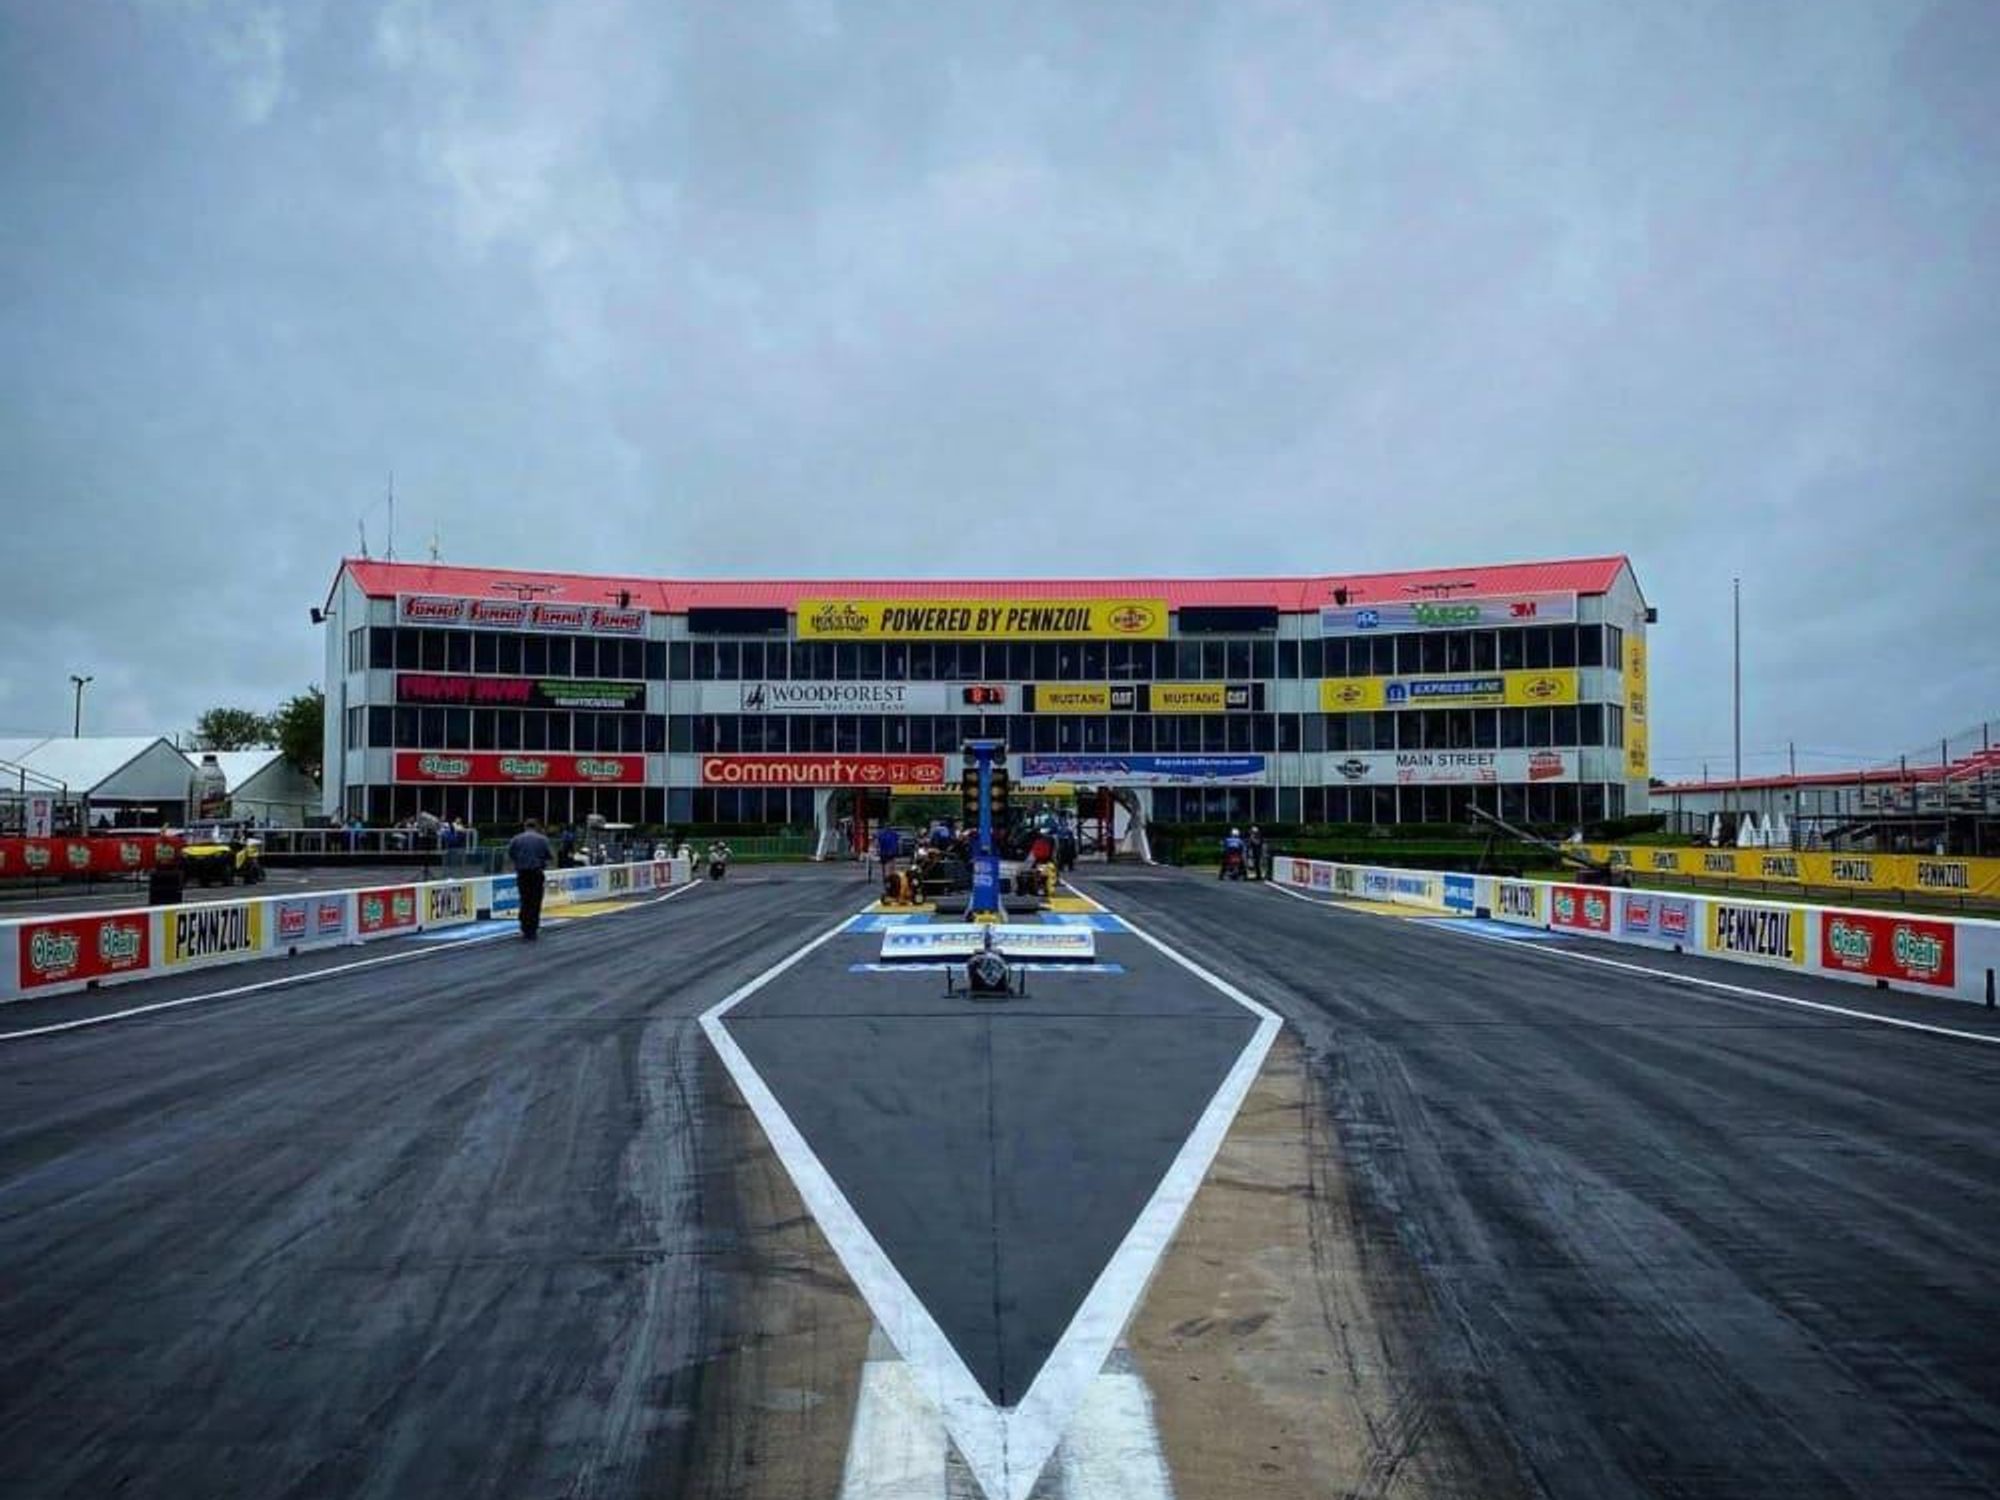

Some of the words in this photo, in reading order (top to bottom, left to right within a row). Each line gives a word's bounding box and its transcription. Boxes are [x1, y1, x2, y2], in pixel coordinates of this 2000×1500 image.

[880, 608, 972, 631] POWERED
[976, 608, 1002, 631] BY
[1006, 608, 1092, 631] PENNZOIL
[1510, 603, 1536, 617] 3M
[772, 685, 907, 702] WOODFOREST
[1048, 693, 1105, 705] MUSTANG
[1163, 692, 1220, 704] MUSTANG
[1395, 753, 1433, 767] MAIN
[1437, 752, 1496, 766] STREET
[703, 758, 861, 782] Community
[1919, 862, 1969, 888] PENNZOIL
[175, 906, 251, 959] PENNZOIL
[1715, 907, 1793, 957] PENNZOIL
